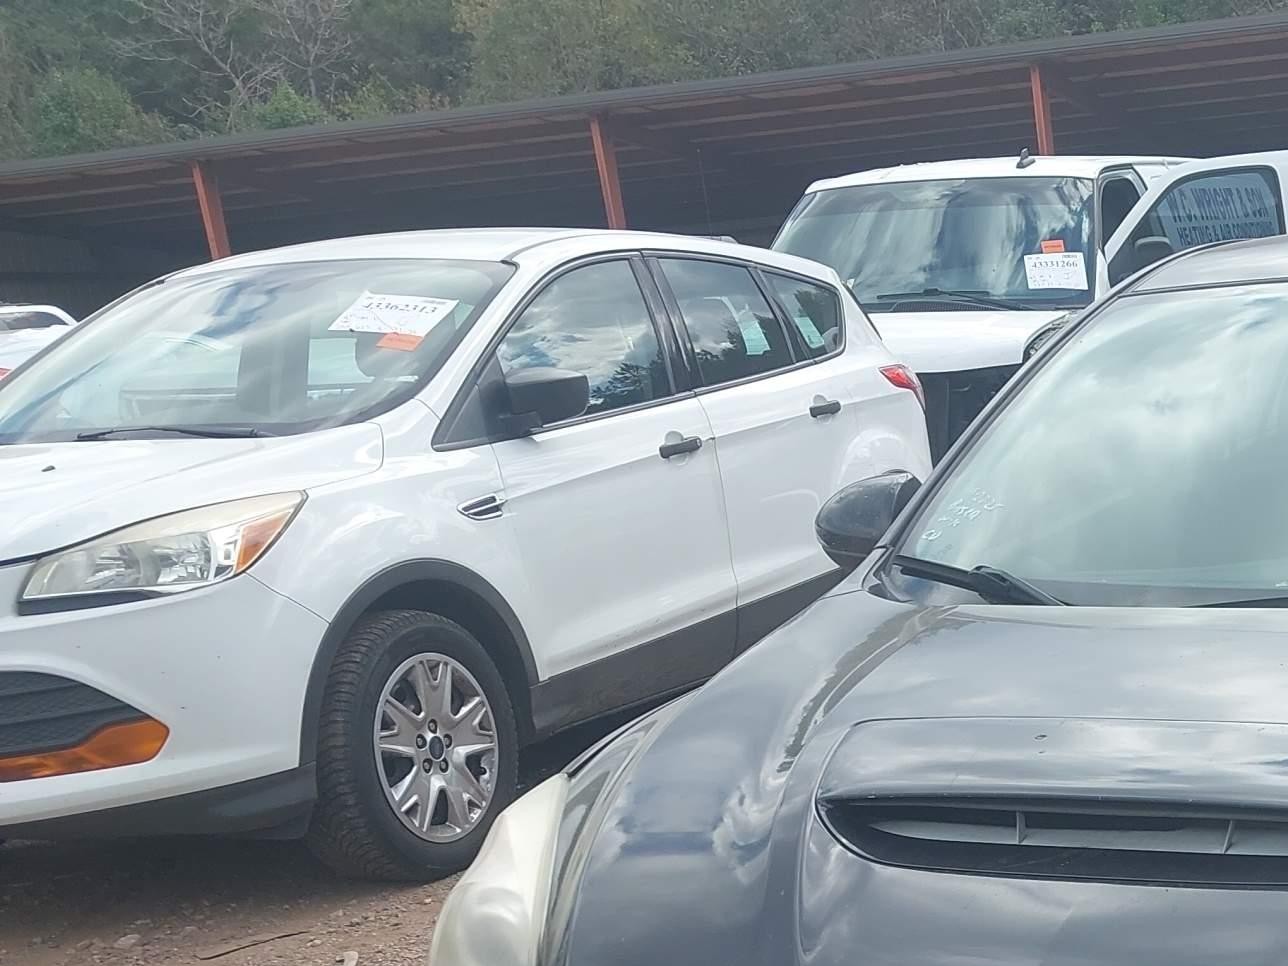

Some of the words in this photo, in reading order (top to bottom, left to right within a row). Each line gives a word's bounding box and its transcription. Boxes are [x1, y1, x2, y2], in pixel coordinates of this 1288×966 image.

[1191, 187, 1239, 220] WRIGHT
[1245, 186, 1269, 217] SON
[1176, 225, 1213, 247] HEATING
